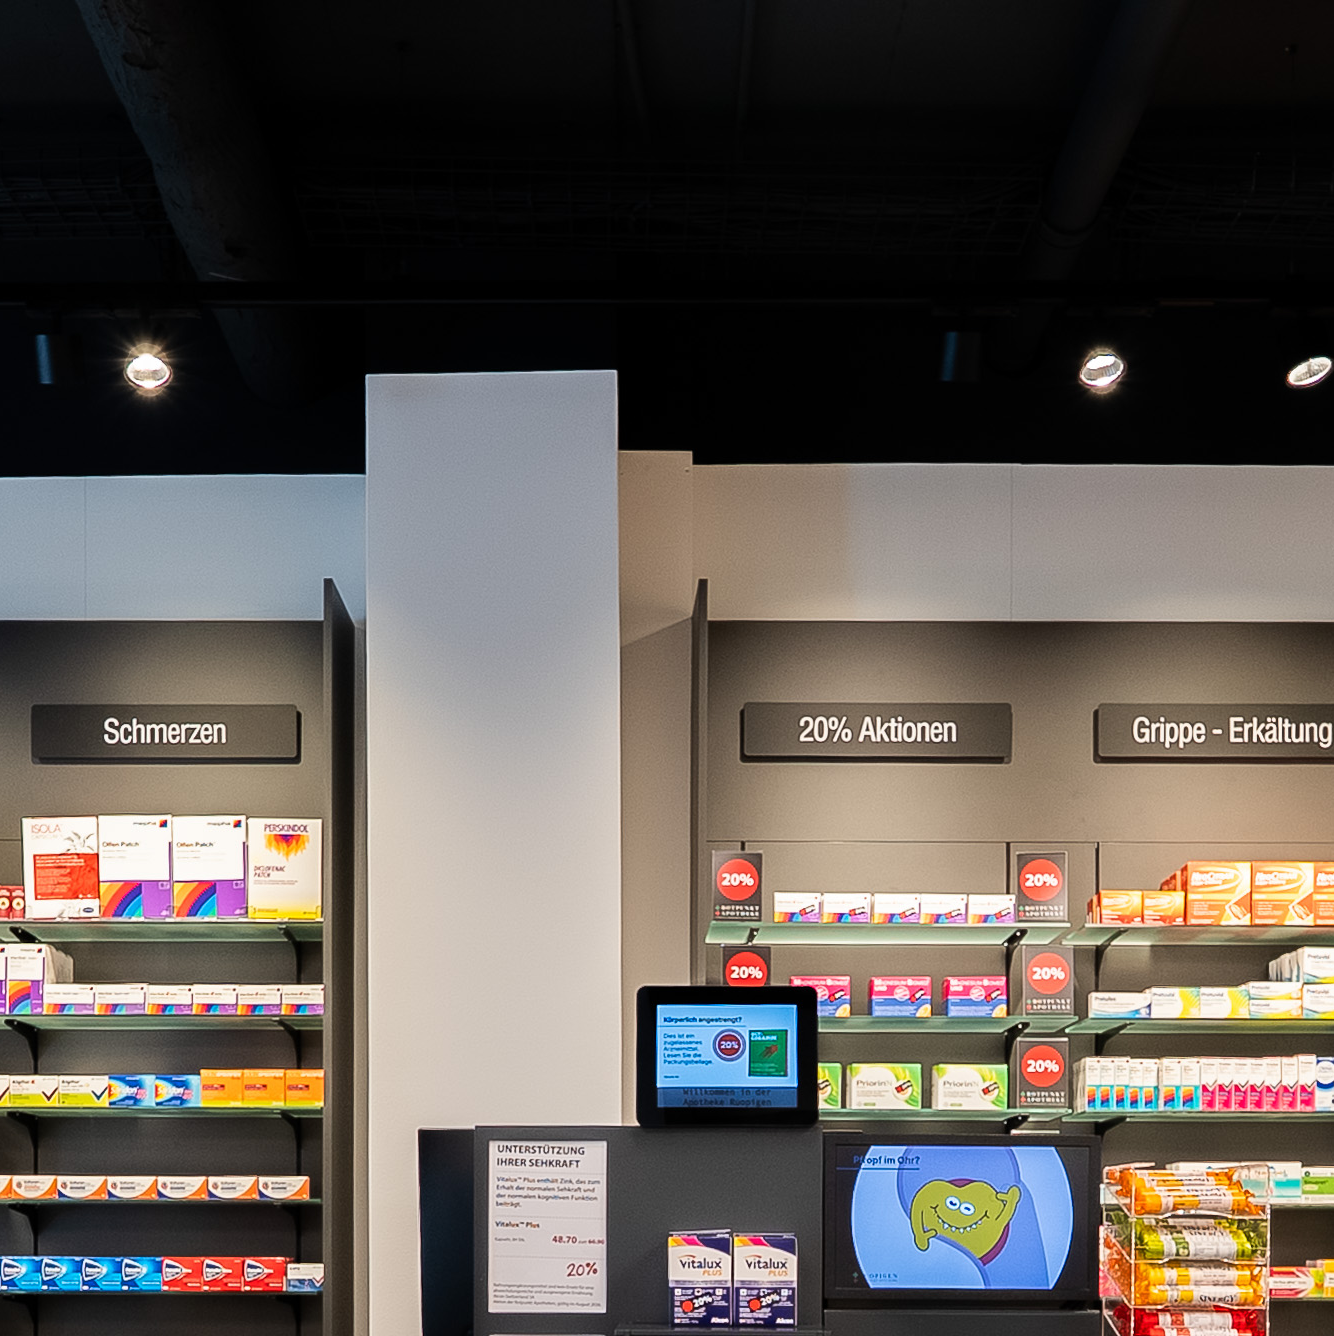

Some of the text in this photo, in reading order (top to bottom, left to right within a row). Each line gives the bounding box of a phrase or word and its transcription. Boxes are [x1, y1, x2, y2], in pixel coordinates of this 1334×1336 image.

[103, 717, 227, 745] Schmerzen
[799, 716, 957, 743] 20% Aktionen
[1132, 716, 1206, 749] Grippe
[1229, 715, 1333, 749] Erkältung
[721, 873, 755, 887] 20%
[1024, 873, 1058, 887] 20%
[730, 966, 763, 980] 20%
[1032, 967, 1065, 980] 20%
[720, 1041, 739, 1049] 20%
[1026, 1060, 1060, 1073] 20%
[683, 1098, 725, 1106] Apotheke
[497, 1143, 585, 1155] UNTERSTÜTZUNG
[496, 1157, 580, 1168] IHRER SEHKRAFT
[884, 1155, 895, 1164] im
[897, 1155, 921, 1165] Ohr?
[552, 1235, 577, 1244] 48.70
[566, 1262, 598, 1277] 20%
[693, 1295, 713, 1307] 20%
[760, 1293, 780, 1306] 20%
